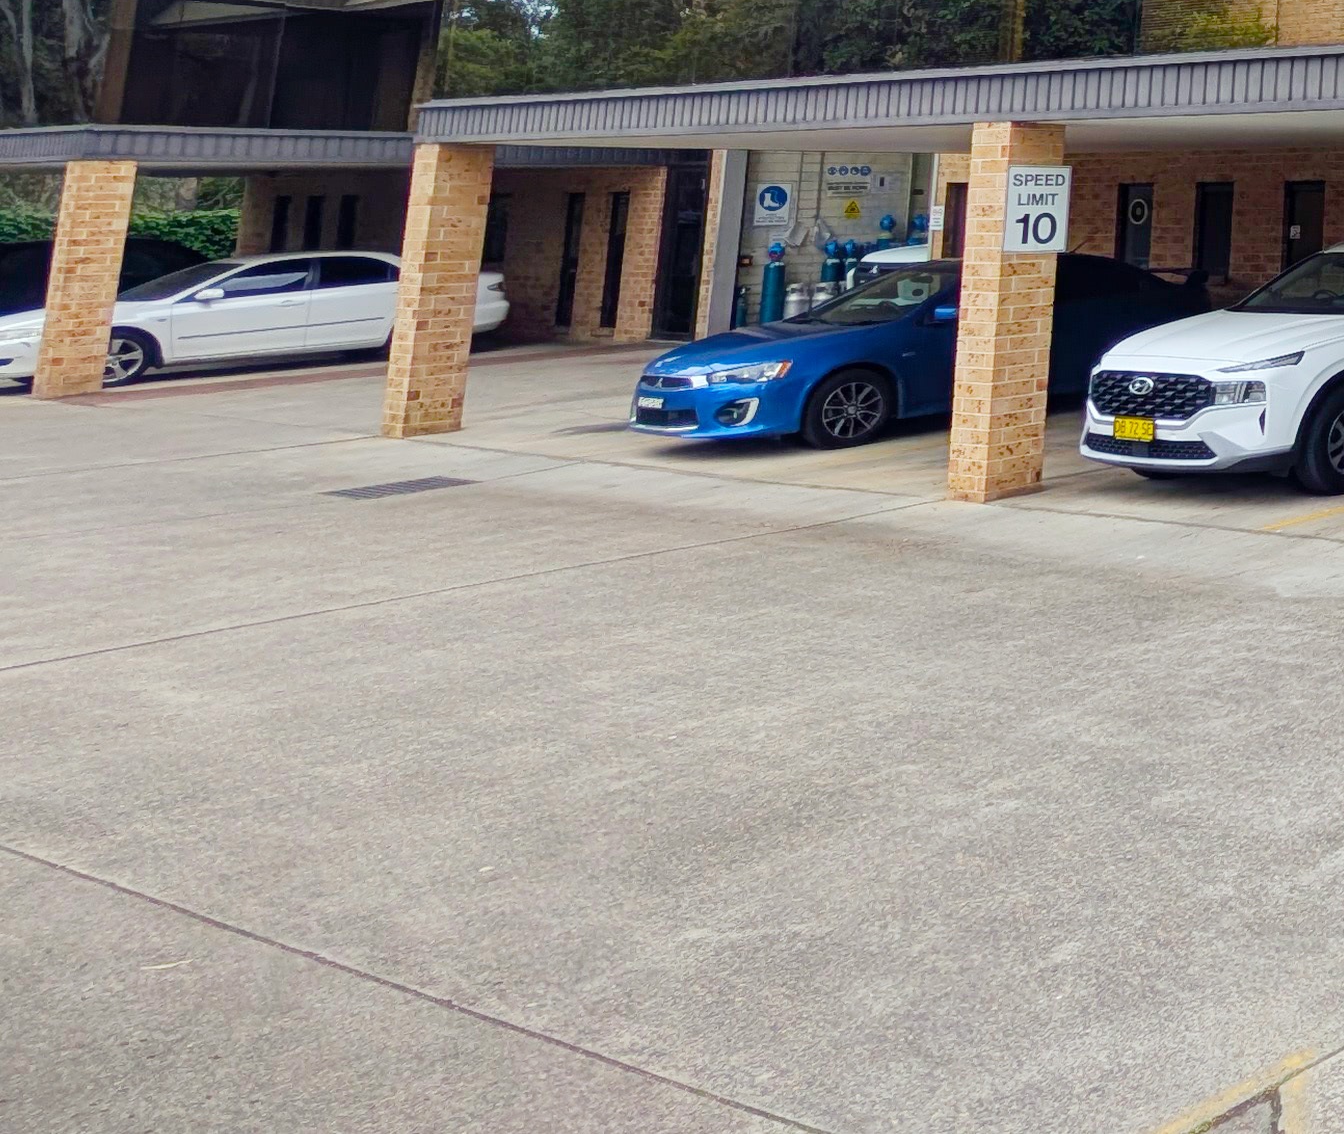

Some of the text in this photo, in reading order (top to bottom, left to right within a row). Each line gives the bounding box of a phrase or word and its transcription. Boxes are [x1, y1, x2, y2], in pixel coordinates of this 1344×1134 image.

[1012, 173, 1066, 187] SPEED
[1017, 193, 1059, 206] LIMIT
[1015, 212, 1057, 245] 10
